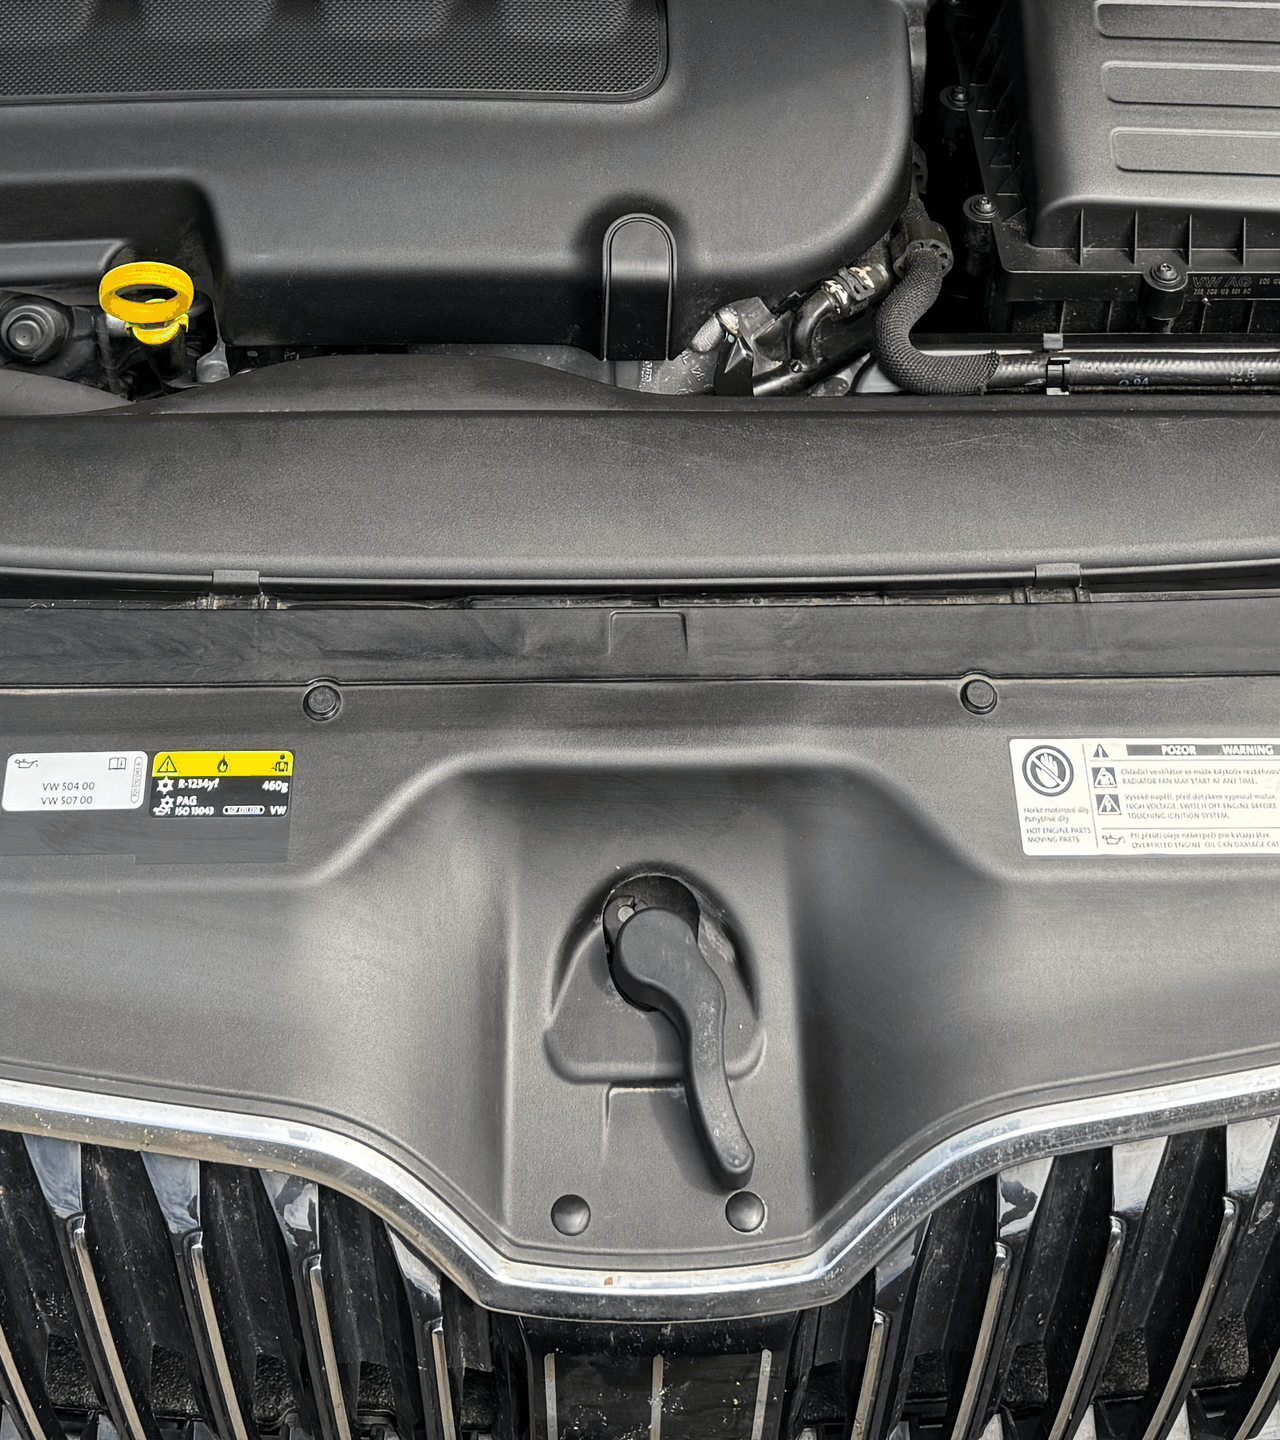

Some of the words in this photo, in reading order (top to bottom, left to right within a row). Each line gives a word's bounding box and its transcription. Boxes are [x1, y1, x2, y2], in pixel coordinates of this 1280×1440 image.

[1224, 276, 1252, 287] AG
[1161, 745, 1197, 755] POZOR
[1221, 745, 1274, 755] WARNING
[42, 783, 60, 791] VW
[62, 782, 79, 791] 504
[82, 782, 95, 790] 00
[262, 781, 289, 793] 460g
[41, 797, 58, 805] VW
[61, 796, 77, 805] 507
[80, 796, 93, 804] 00
[176, 796, 197, 805] PAG
[175, 806, 190, 815] ISO
[270, 805, 287, 815] VW
